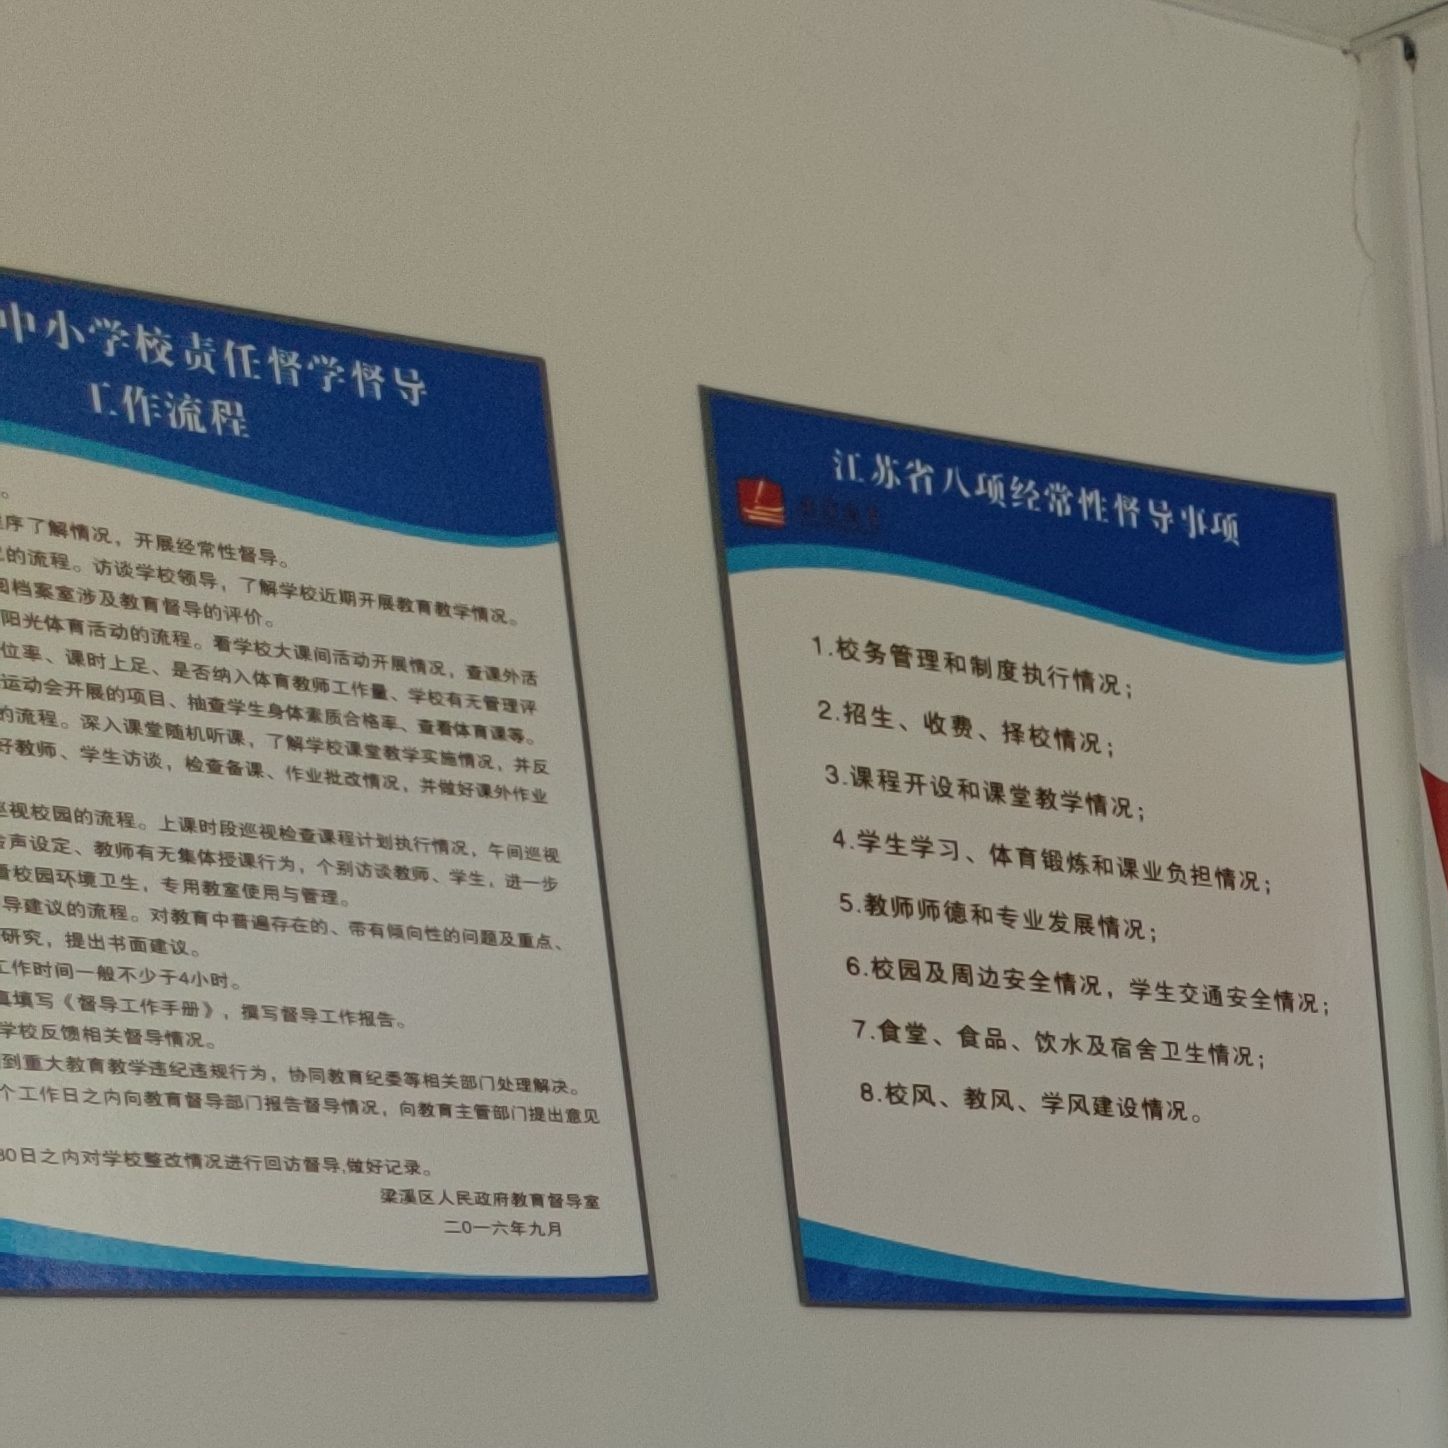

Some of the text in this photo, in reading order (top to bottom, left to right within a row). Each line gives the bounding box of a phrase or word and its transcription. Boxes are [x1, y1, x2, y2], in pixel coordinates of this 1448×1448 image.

[86, 381, 250, 439] 工作流程
[831, 448, 1241, 546] 江苏省八项经常性督导事项
[0, 513, 288, 569] 序了解情况,开展经常性督导。
[0, 549, 518, 626] 的流程。访谈学校领导,了解学校近期开展教育教学情况。
